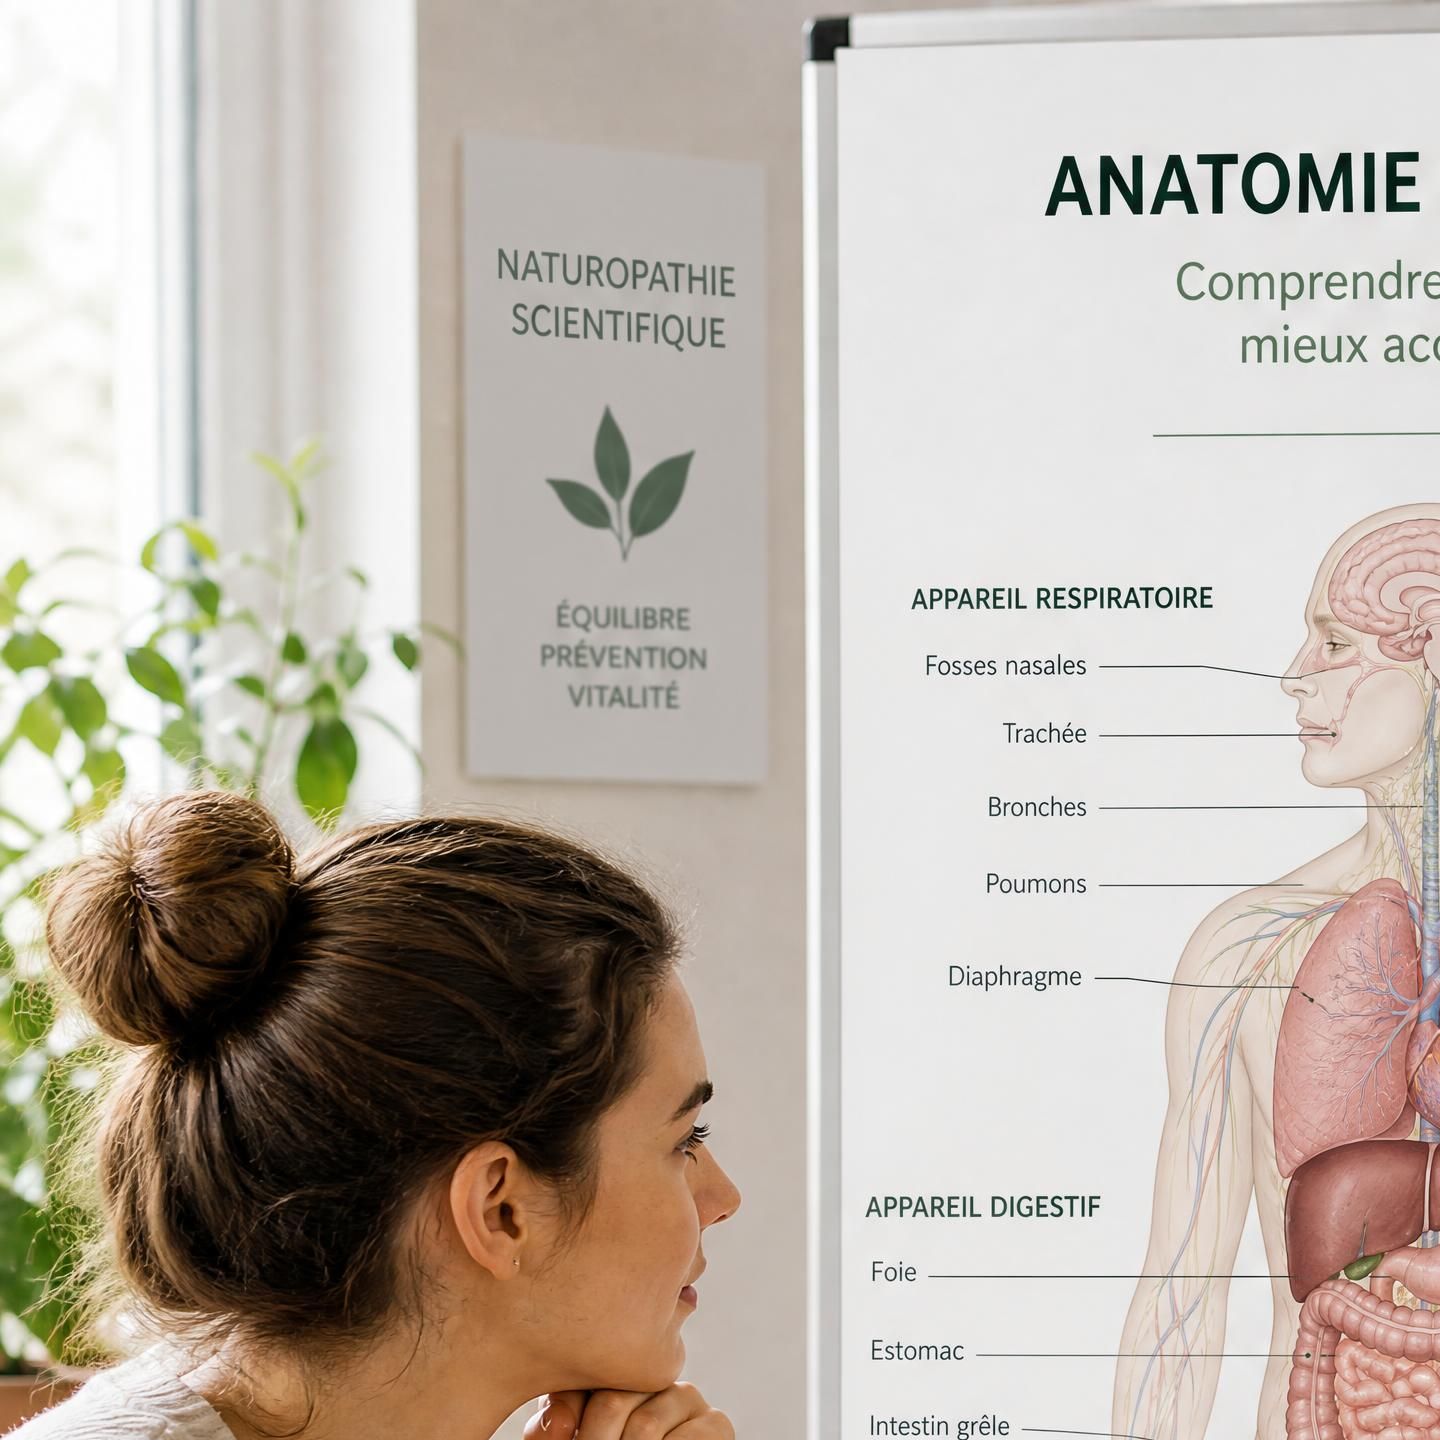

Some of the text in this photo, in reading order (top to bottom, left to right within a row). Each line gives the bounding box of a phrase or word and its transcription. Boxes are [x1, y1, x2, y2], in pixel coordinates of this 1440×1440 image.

[1045, 152, 1420, 216] ANATOMIE
[498, 248, 735, 297] NATUROPATHIE
[512, 303, 726, 352] SCIENTIFIQUE
[1242, 324, 1368, 363] mieux
[912, 587, 1213, 609] APPAREIL RESPIRATOIRE
[557, 600, 690, 633] ÉQUILIBRE
[541, 641, 707, 670] PRÉVENTION
[927, 654, 1086, 675] Fosses nasales
[568, 681, 680, 709] VITALITÉ
[1003, 722, 1086, 743] Trachée
[989, 796, 1086, 816] Bronches
[987, 873, 1086, 893] Poumons
[950, 965, 1081, 991] Diaphragme
[865, 1196, 1100, 1217] APPAREIL DIGESTIF
[873, 1261, 916, 1281] Foie
[872, 1340, 964, 1360] Estomac
[871, 1415, 1009, 1440] Intestin grêle
